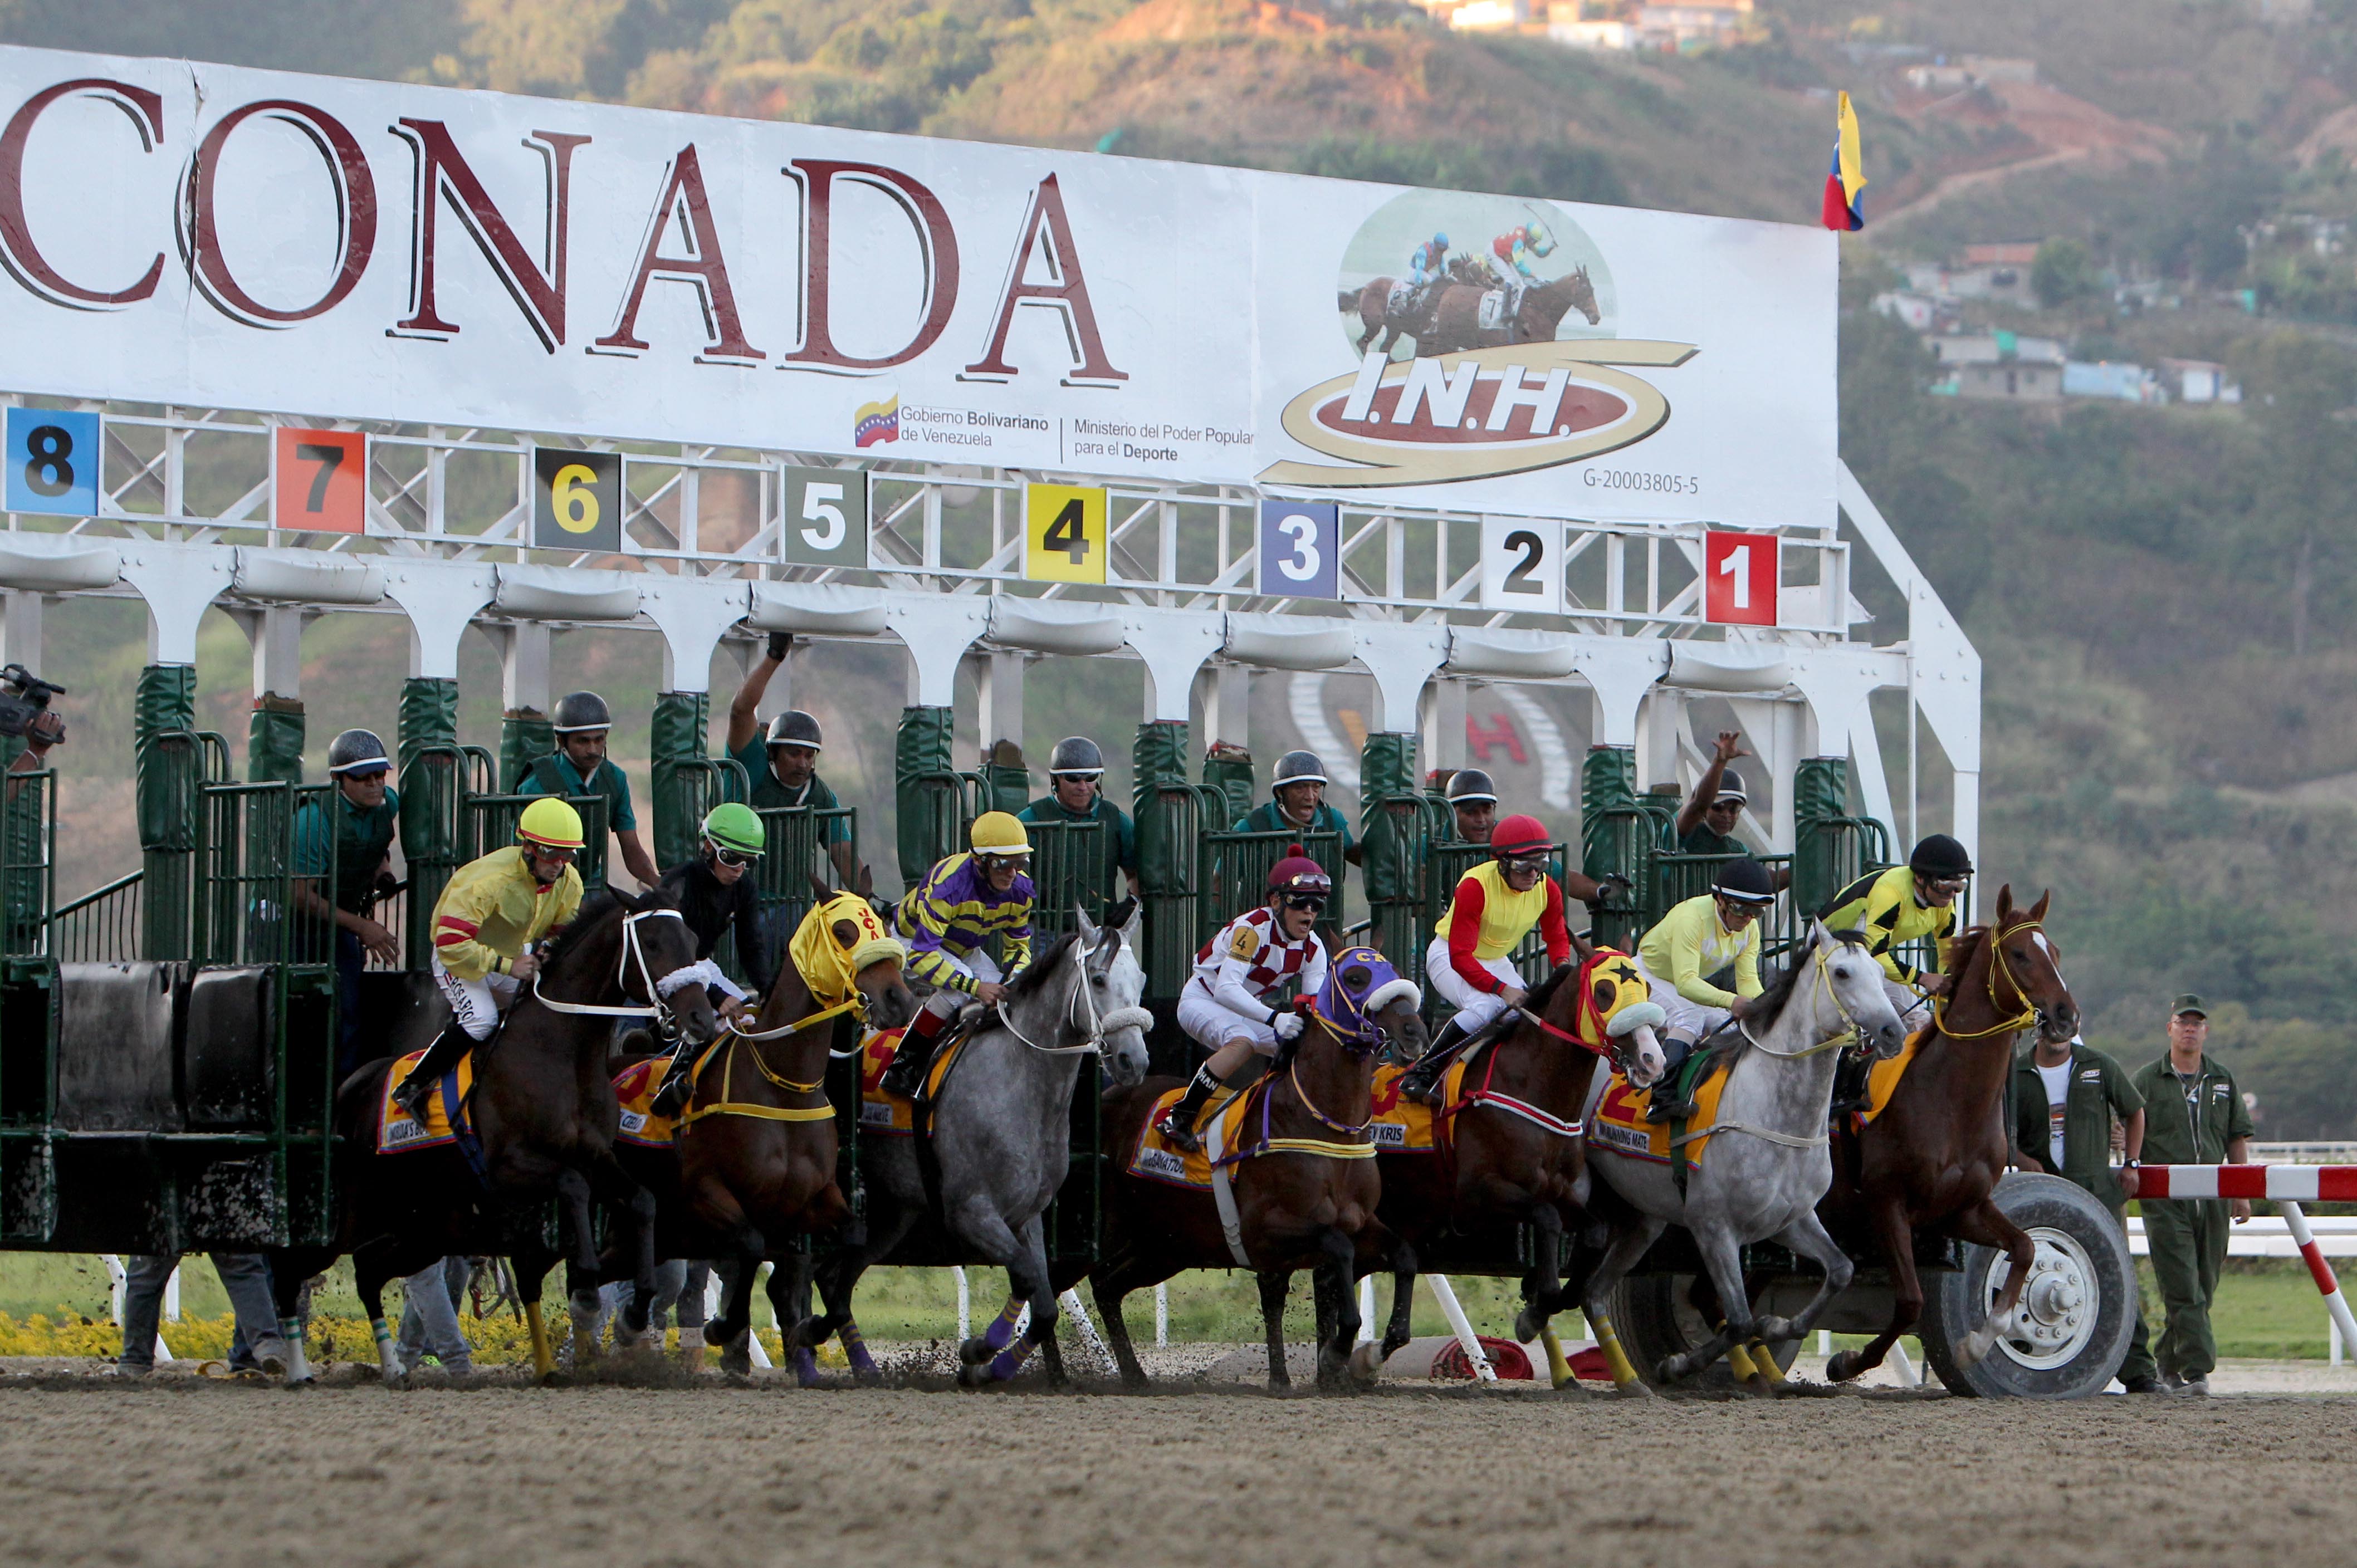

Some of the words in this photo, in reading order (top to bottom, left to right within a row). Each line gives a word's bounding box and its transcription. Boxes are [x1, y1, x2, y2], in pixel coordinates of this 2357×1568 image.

[0, 78, 1128, 388] CONADA
[901, 406, 963, 424] Gobierno
[967, 411, 1049, 430] Bolivariano
[1341, 351, 1572, 437] I.N.H.
[25, 425, 74, 497] 8
[901, 427, 918, 441] de
[922, 427, 992, 446] Venezuela
[1074, 418, 1136, 437] Ministerio
[1140, 423, 1159, 438] del
[1163, 425, 1202, 441] Poder
[1205, 427, 1254, 446] Popular
[1074, 442, 1104, 456] para
[1107, 442, 1119, 455] el
[1124, 443, 1178, 462] Deporte
[296, 443, 344, 513] 7
[551, 464, 600, 533] 6
[1583, 468, 1699, 494] G-20003805-5
[800, 482, 846, 551] 5
[1043, 498, 1089, 565] 4
[1278, 514, 1321, 581] 3
[1502, 530, 1544, 595] 2
[1720, 545, 1750, 609] 1
[1236, 934, 1246, 950] 4
[1378, 1126, 1402, 1141] KRIS
[1632, 1132, 1647, 1149] MATE
